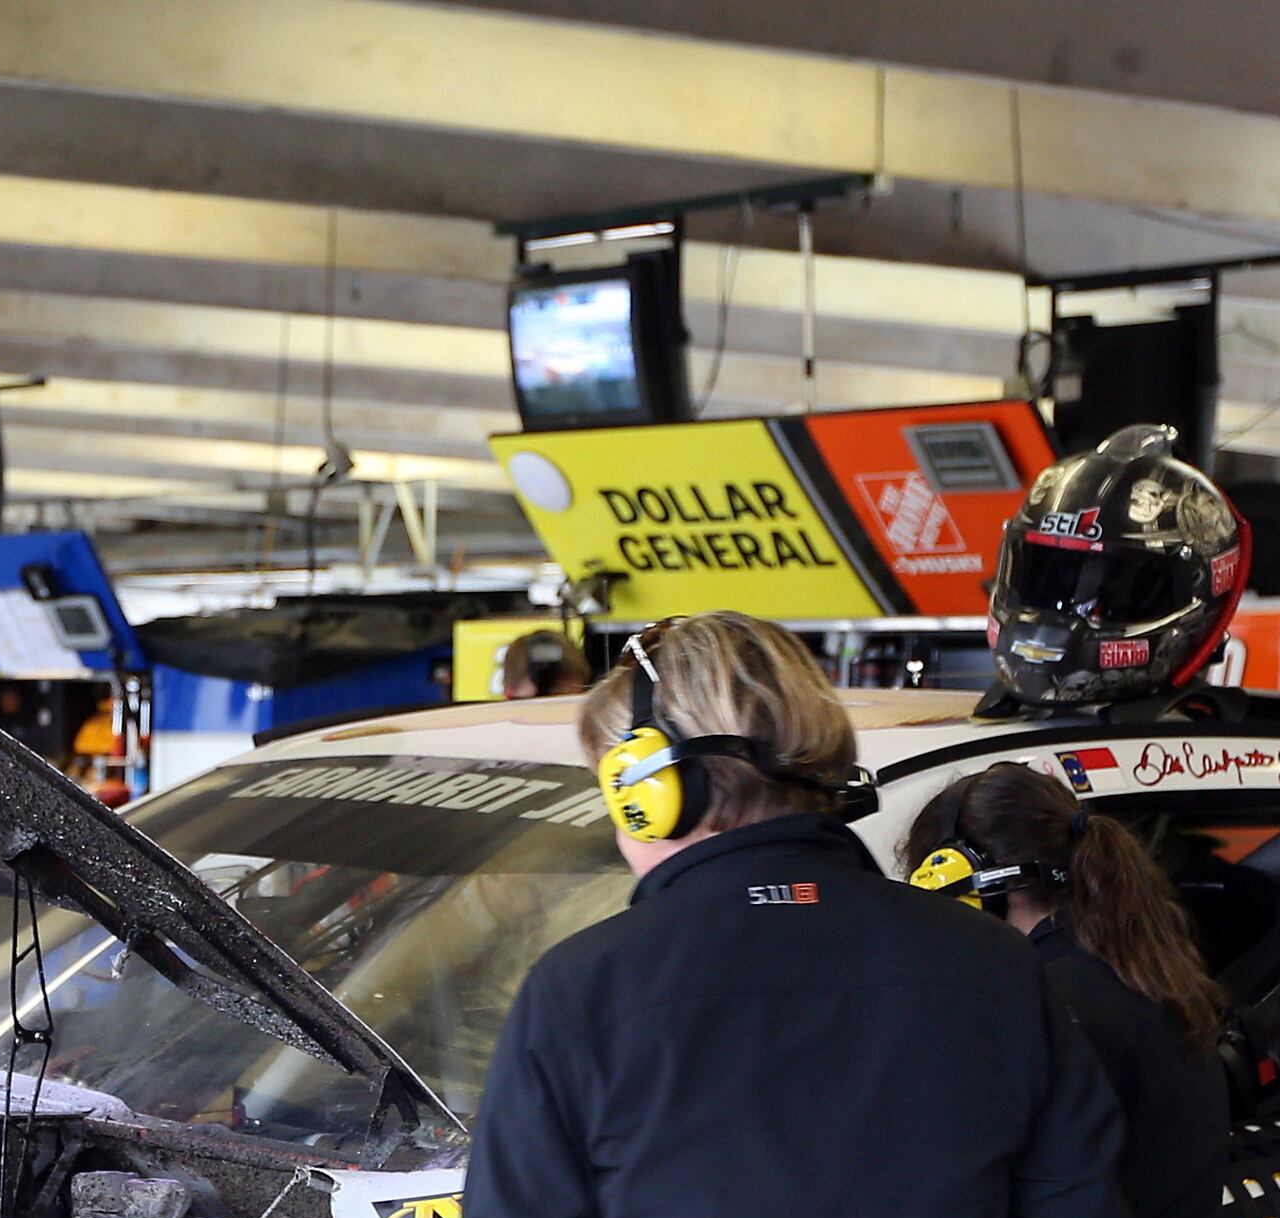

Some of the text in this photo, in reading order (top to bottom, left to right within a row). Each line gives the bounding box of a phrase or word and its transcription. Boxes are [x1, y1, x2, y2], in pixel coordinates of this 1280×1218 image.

[599, 482, 797, 525] DOLLAR
[618, 529, 838, 571] GENERAL
[1100, 648, 1149, 668] GUARD
[229, 767, 564, 814] EARNHARDT
